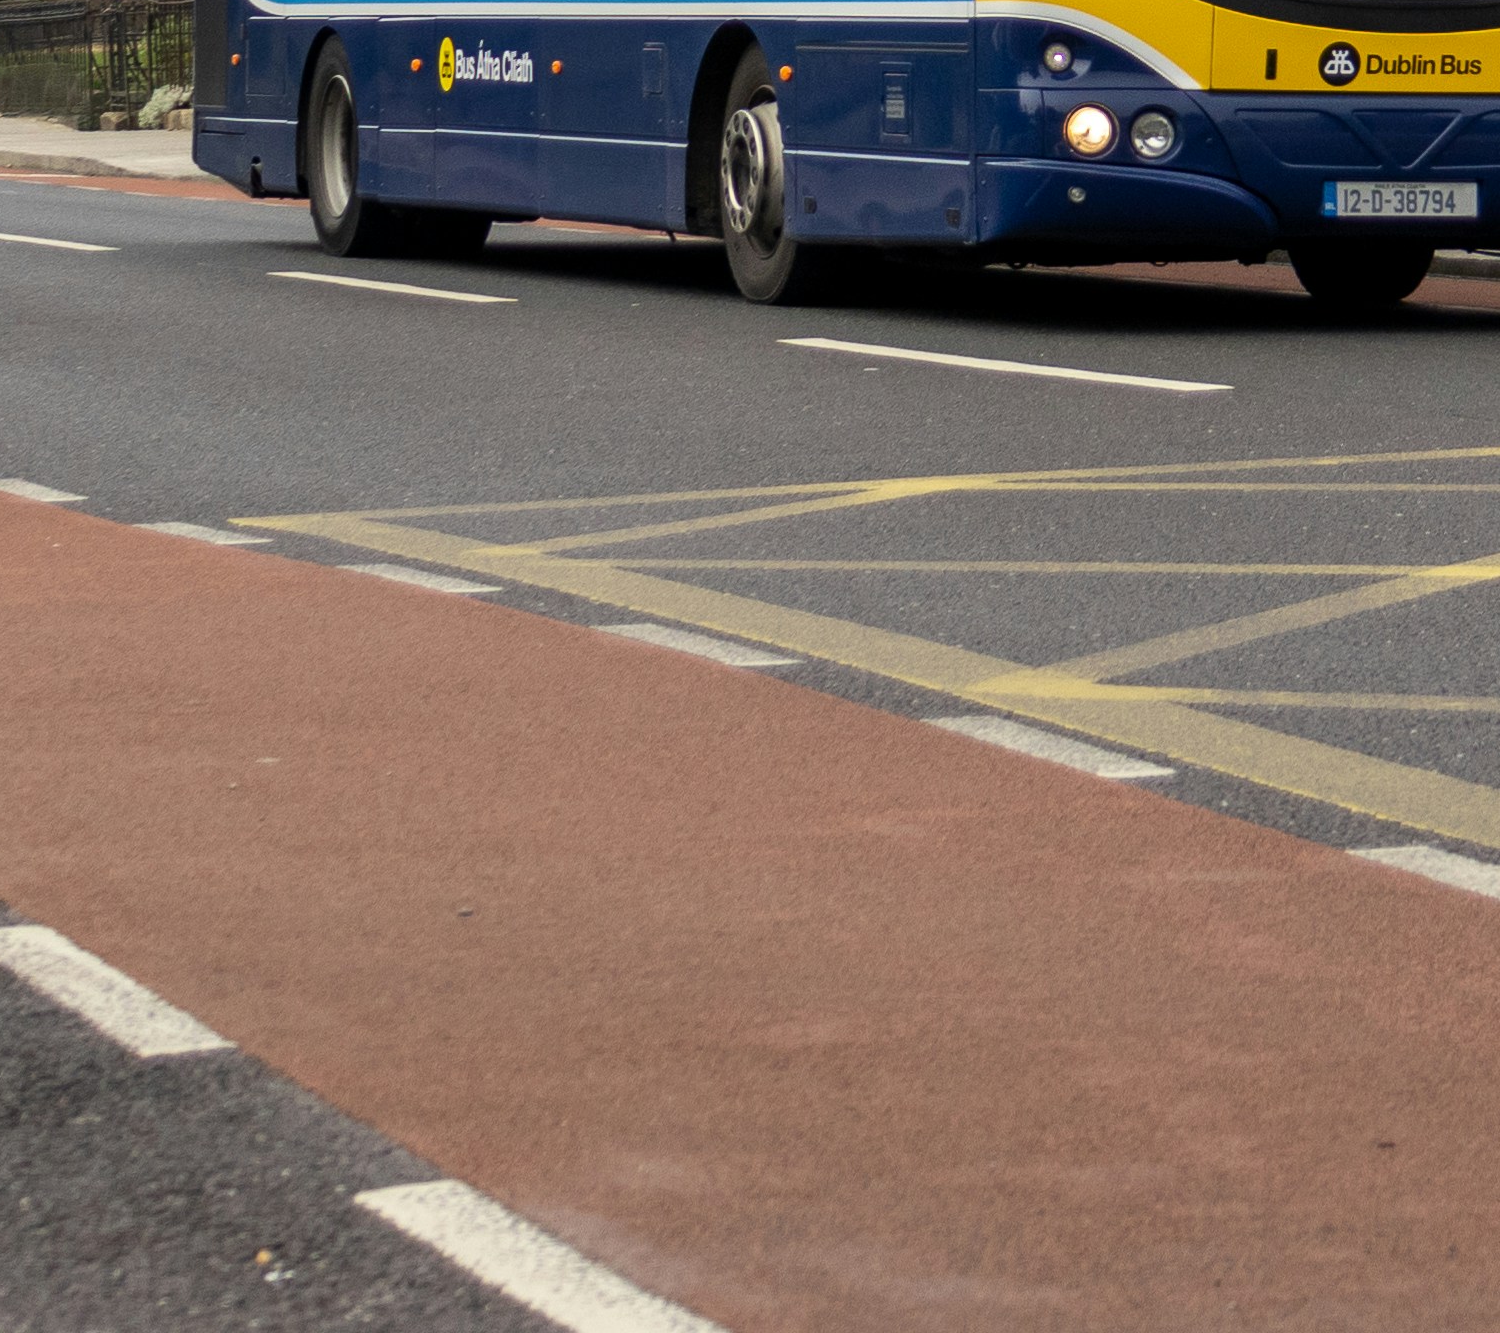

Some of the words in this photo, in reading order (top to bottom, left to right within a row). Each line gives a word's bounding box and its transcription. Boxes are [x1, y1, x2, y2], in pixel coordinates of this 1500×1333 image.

[455, 49, 475, 80] Bus
[476, 39, 501, 81] Átha
[502, 50, 534, 83] Cliath
[1366, 54, 1436, 76] Dublin
[1440, 55, 1482, 76] Bus
[1341, 189, 1456, 214] 12-D-38794
